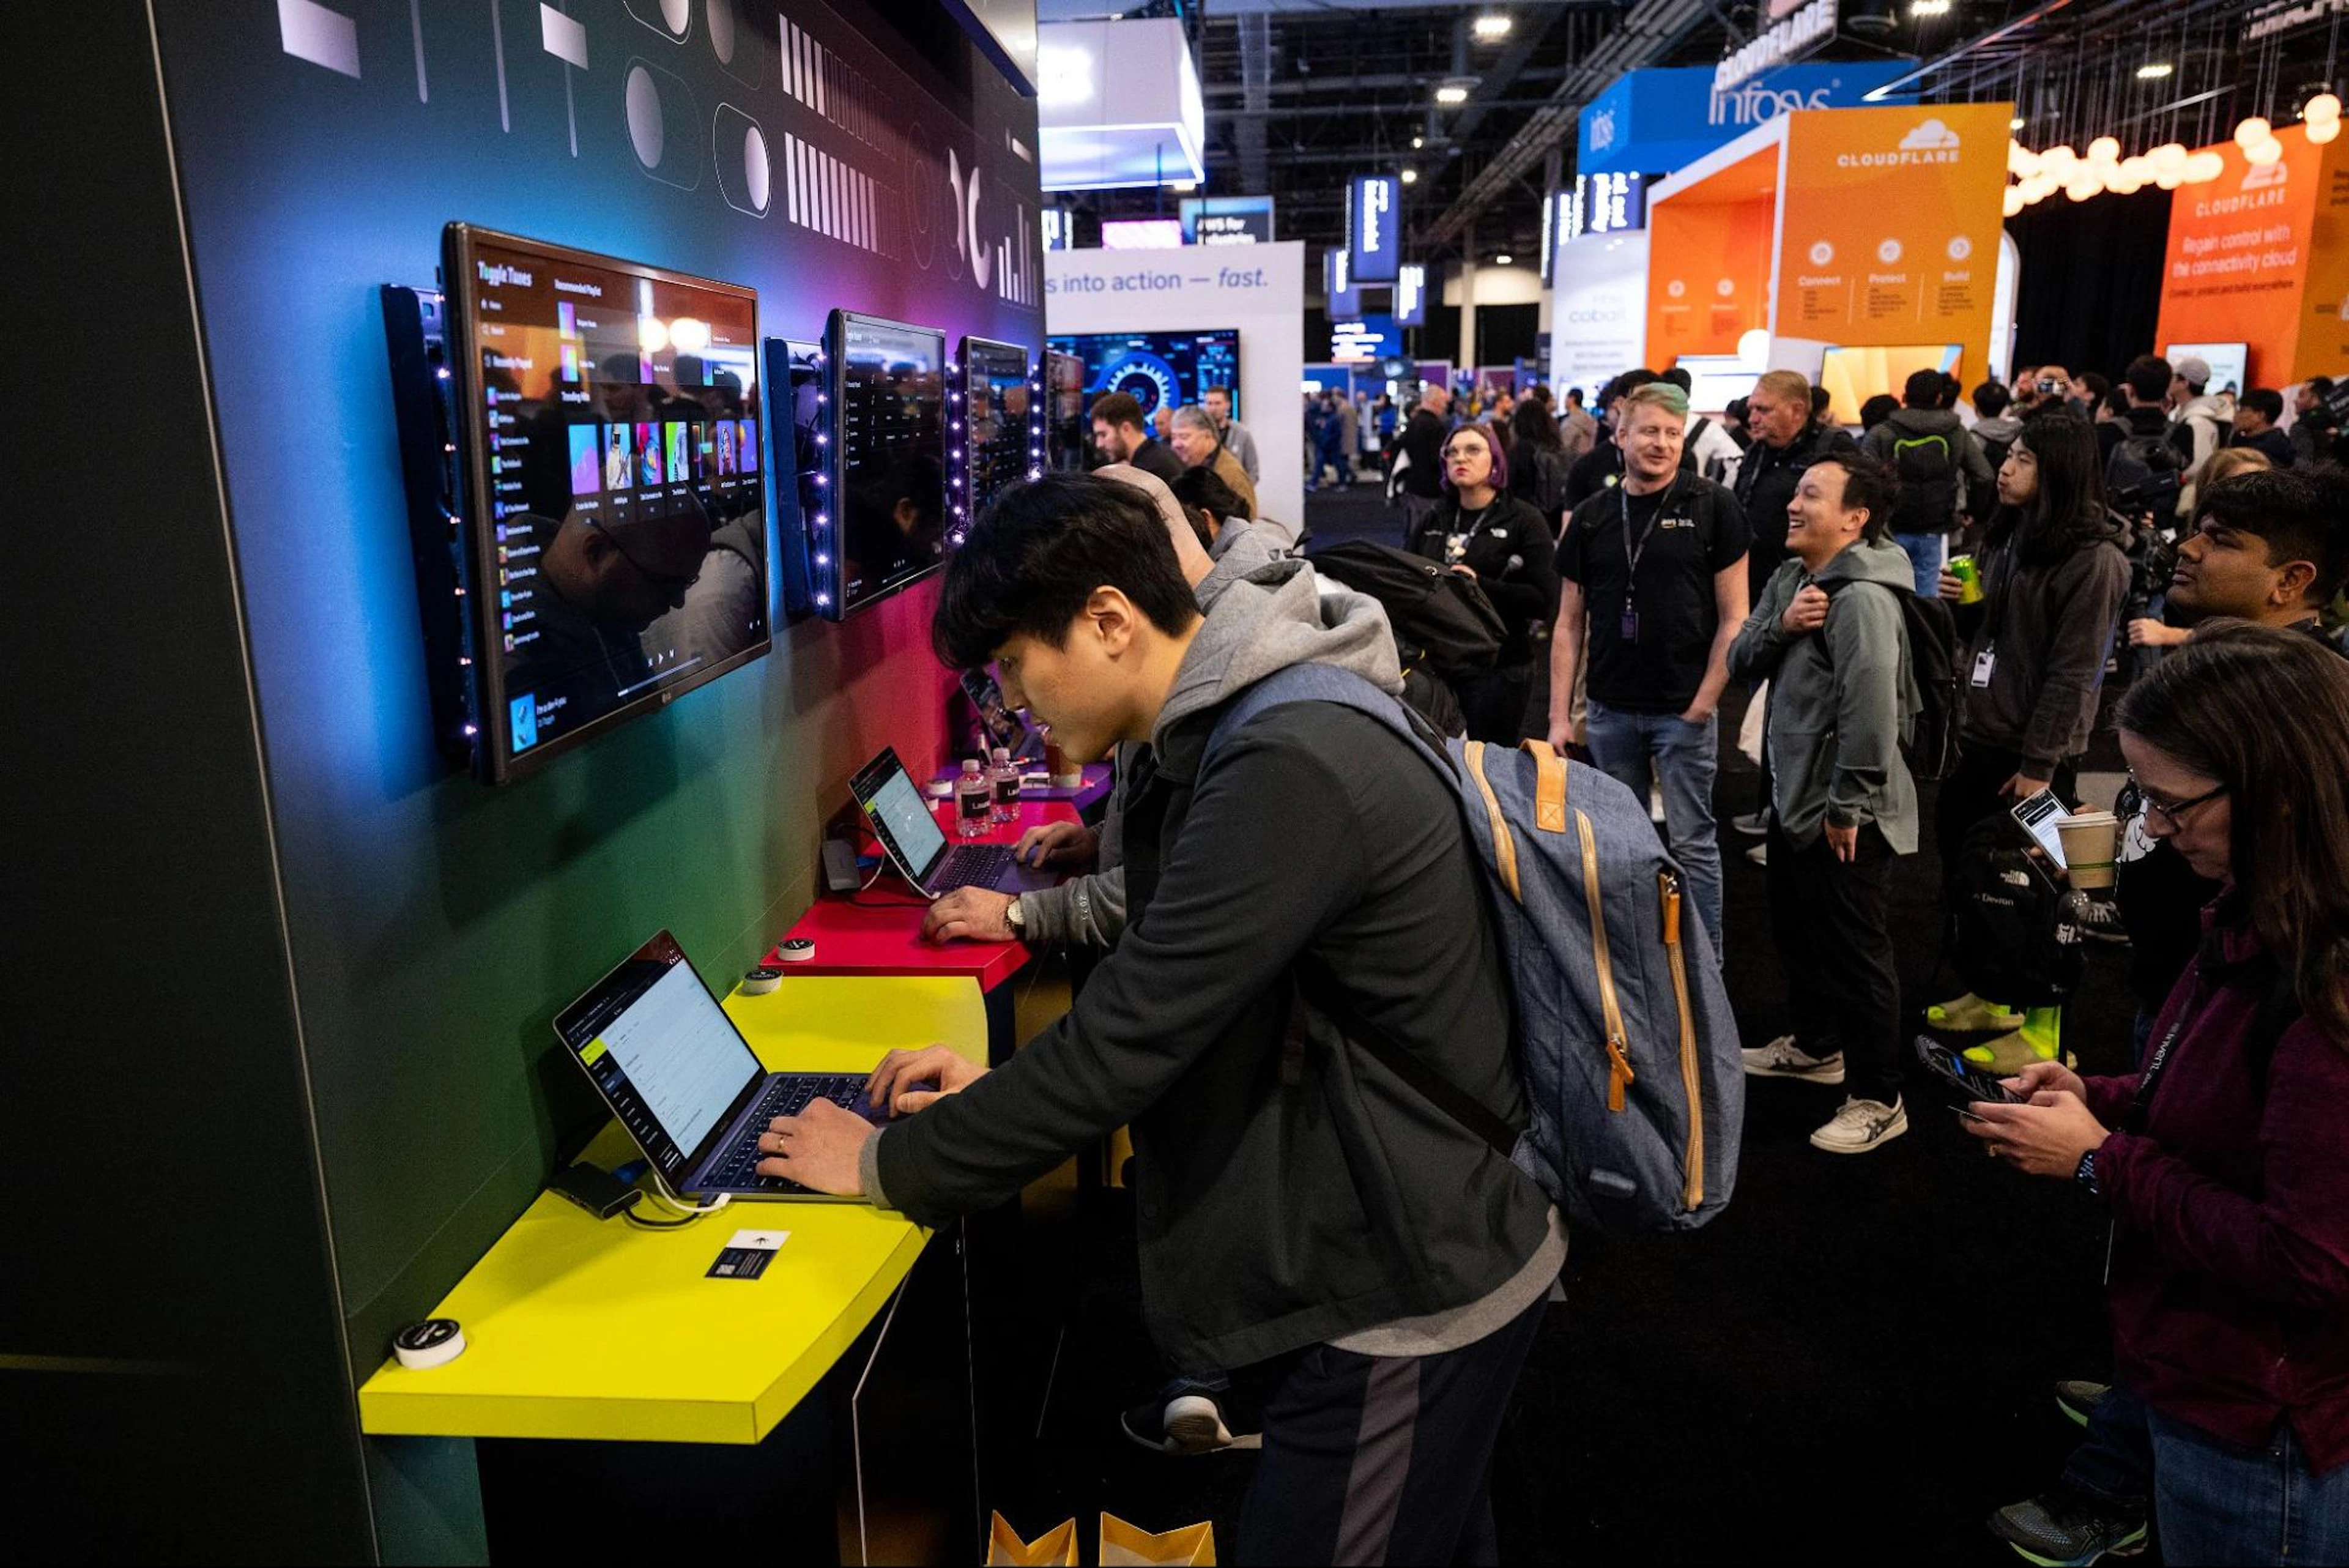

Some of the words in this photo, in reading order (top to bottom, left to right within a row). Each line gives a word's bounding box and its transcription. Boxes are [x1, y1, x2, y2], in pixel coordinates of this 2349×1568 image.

[1715, 0, 1835, 91] CLOUDFLARE
[1837, 150, 1959, 167] CLOUDFLARE
[2195, 188, 2285, 218] CLOUDFLARE
[2183, 236, 2219, 257] Regain
[2221, 228, 2262, 250] control
[2263, 224, 2290, 243] with
[477, 259, 507, 287] Toggle
[2191, 253, 2260, 273] connectivity
[2262, 246, 2298, 268] cloud
[1064, 273, 1105, 292] into
[1112, 270, 1182, 291] action
[1218, 267, 1268, 288] fast.
